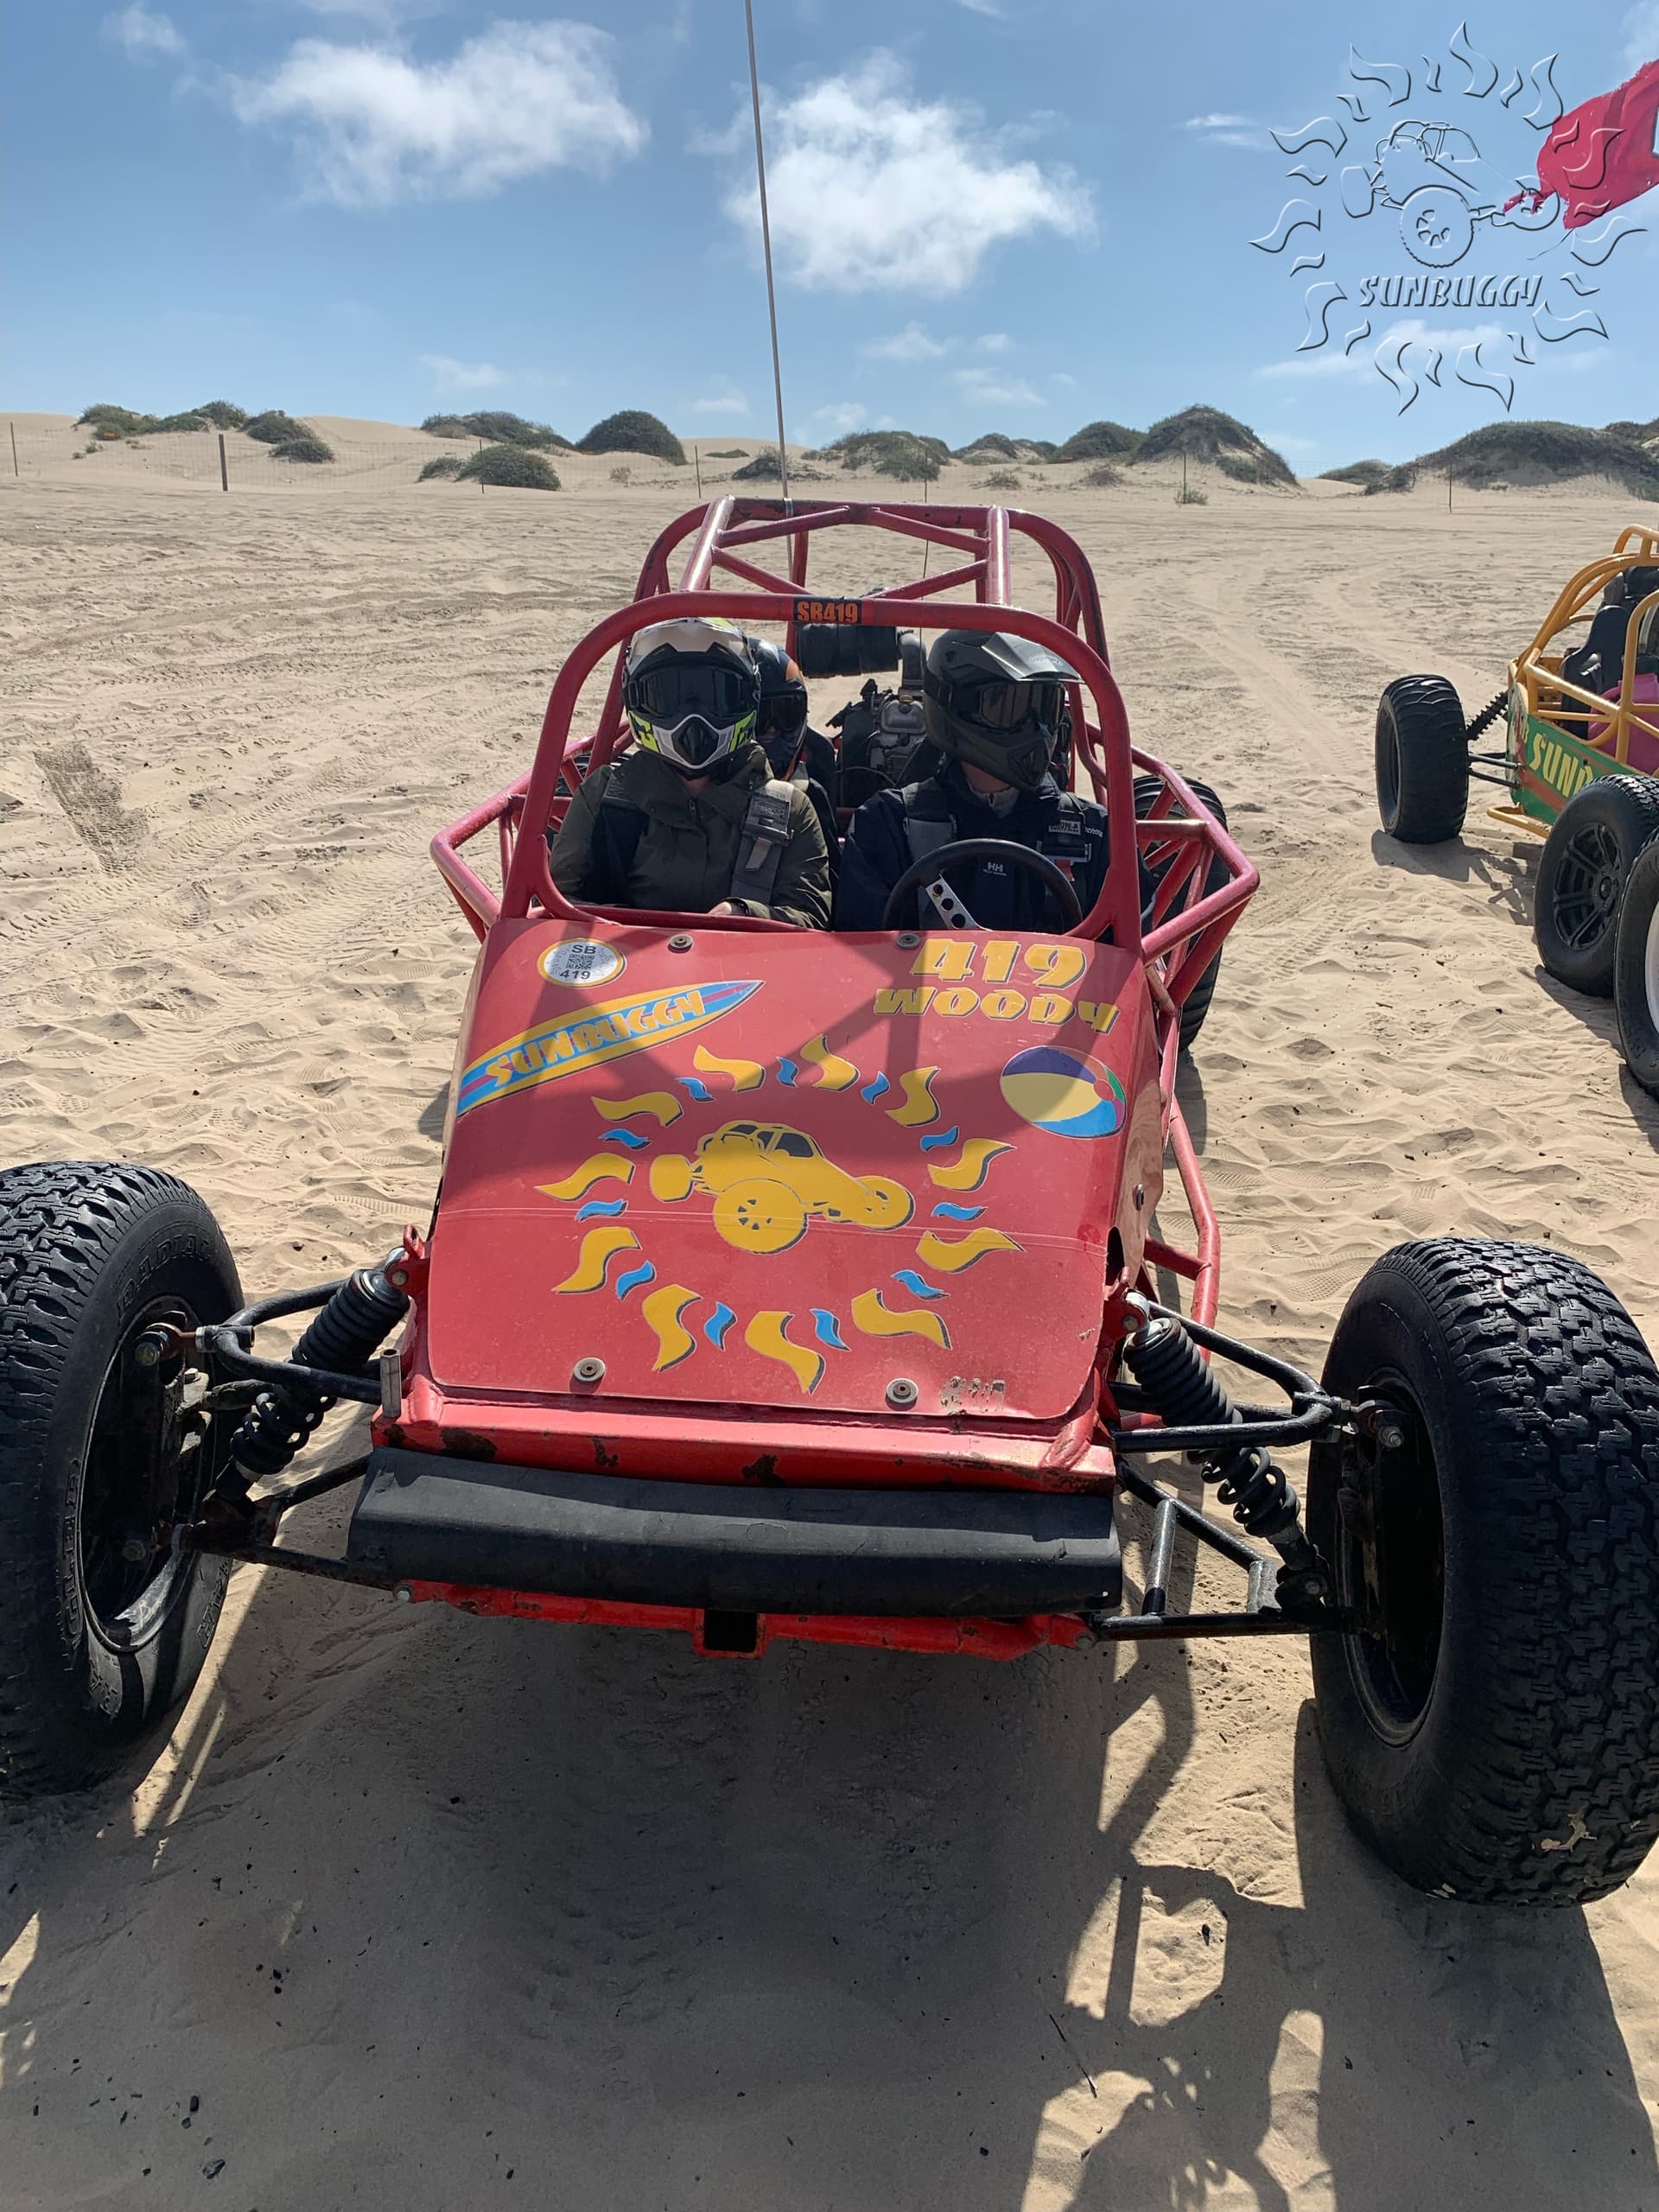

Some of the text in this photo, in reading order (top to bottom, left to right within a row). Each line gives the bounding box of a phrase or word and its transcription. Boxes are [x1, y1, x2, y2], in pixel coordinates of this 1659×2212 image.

[797, 601, 858, 623] SB419
[571, 944, 596, 954] SB
[909, 938, 1087, 989] 419
[560, 969, 591, 980] 419
[873, 987, 1120, 1036] WOODY
[485, 989, 707, 1089] SUNBUGGY
